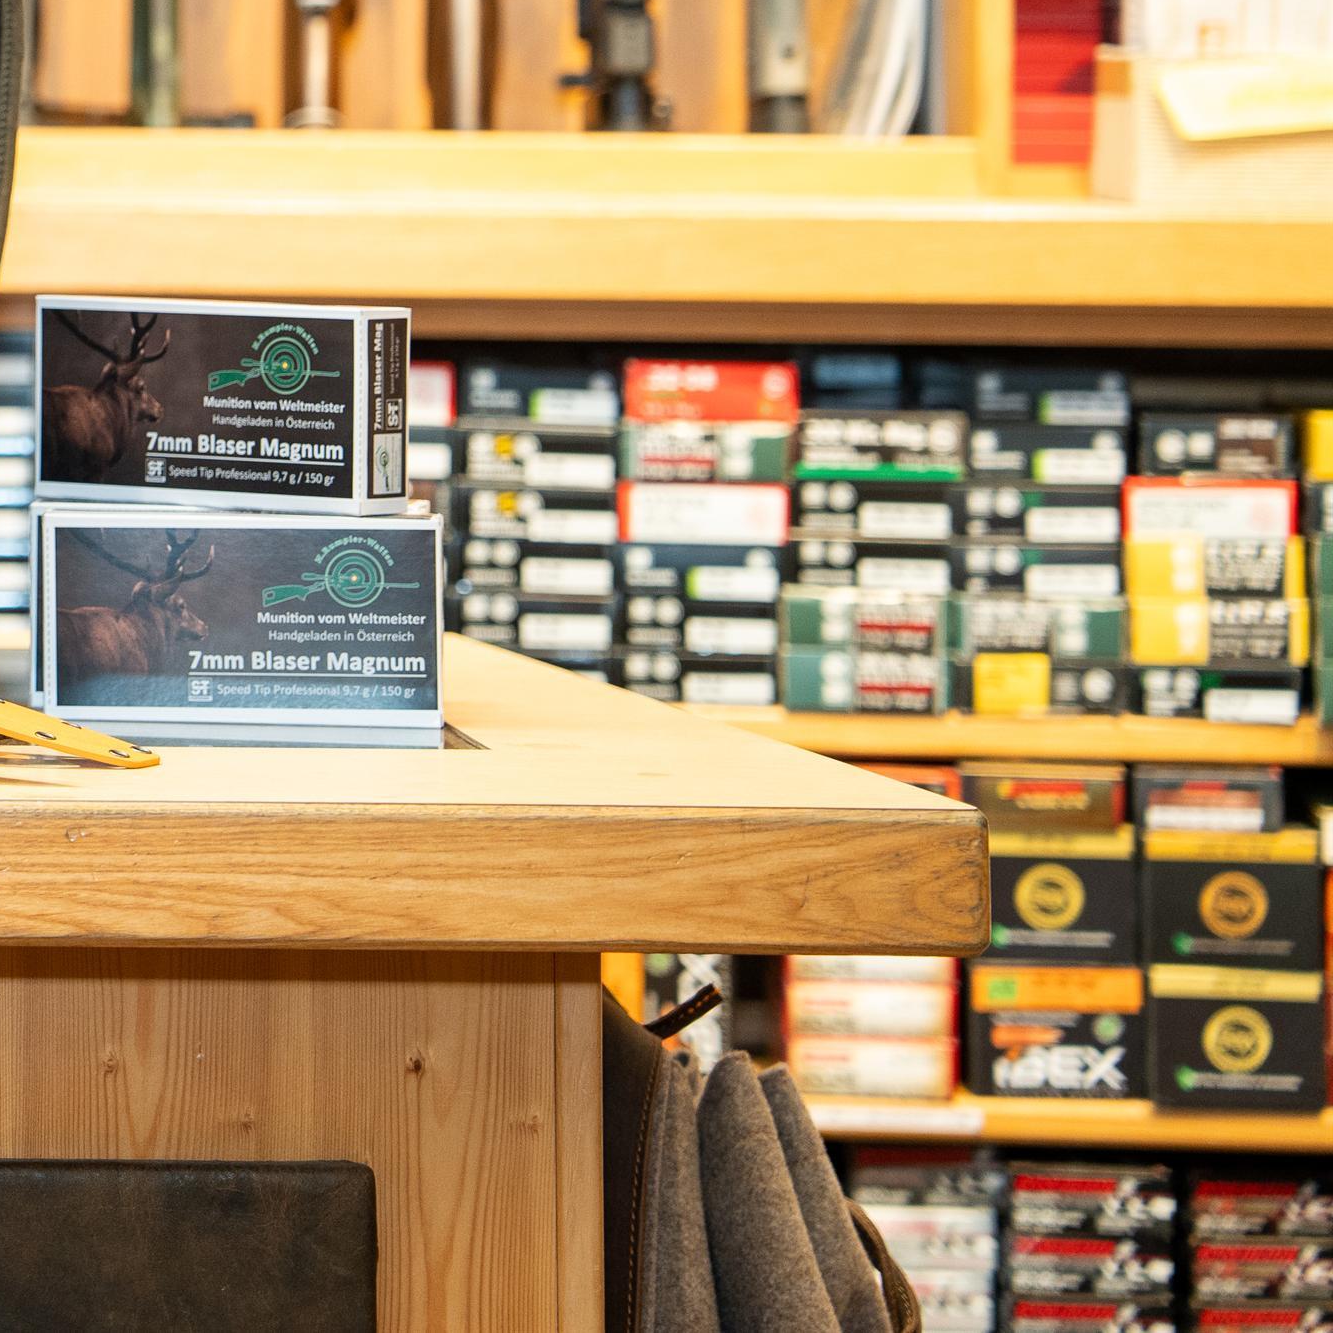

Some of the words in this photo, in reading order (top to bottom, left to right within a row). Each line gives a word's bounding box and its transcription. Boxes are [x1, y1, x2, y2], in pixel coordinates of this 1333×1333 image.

[374, 322, 384, 352] Mag
[373, 355, 382, 395] Blaser
[203, 395, 251, 410] Munition
[253, 400, 277, 411] vom
[279, 399, 346, 414] Weltmeister
[374, 397, 383, 431] 7mm
[212, 414, 273, 429] Handgeladen
[275, 417, 284, 427] in
[286, 416, 335, 429] Österreich
[146, 431, 193, 453] 7mm
[197, 434, 255, 456] Blaser
[260, 436, 344, 462] Magnum
[168, 464, 198, 479] Speed
[199, 465, 214, 479] Tip
[215, 467, 271, 481] Professional
[272, 470, 288, 484] 9,7
[289, 474, 296, 485] g
[297, 471, 303, 485] /
[305, 472, 323, 484] 150
[324, 475, 335, 487] gr
[257, 611, 315, 624] Munition
[318, 615, 346, 625] vom
[348, 612, 426, 625] Weltmeister
[268, 630, 341, 643] Handgeladen
[343, 631, 355, 641] in
[357, 628, 414, 642] Österreich
[189, 650, 244, 670] 7mm
[251, 650, 320, 670] Blaser
[327, 652, 426, 675] Magnum
[217, 683, 251, 697] Speed
[253, 684, 270, 697] Tip
[273, 684, 341, 696] Professional
[362, 688, 370, 699] g
[371, 685, 378, 697] /
[382, 685, 402, 697] 150
[404, 688, 417, 699] gr
